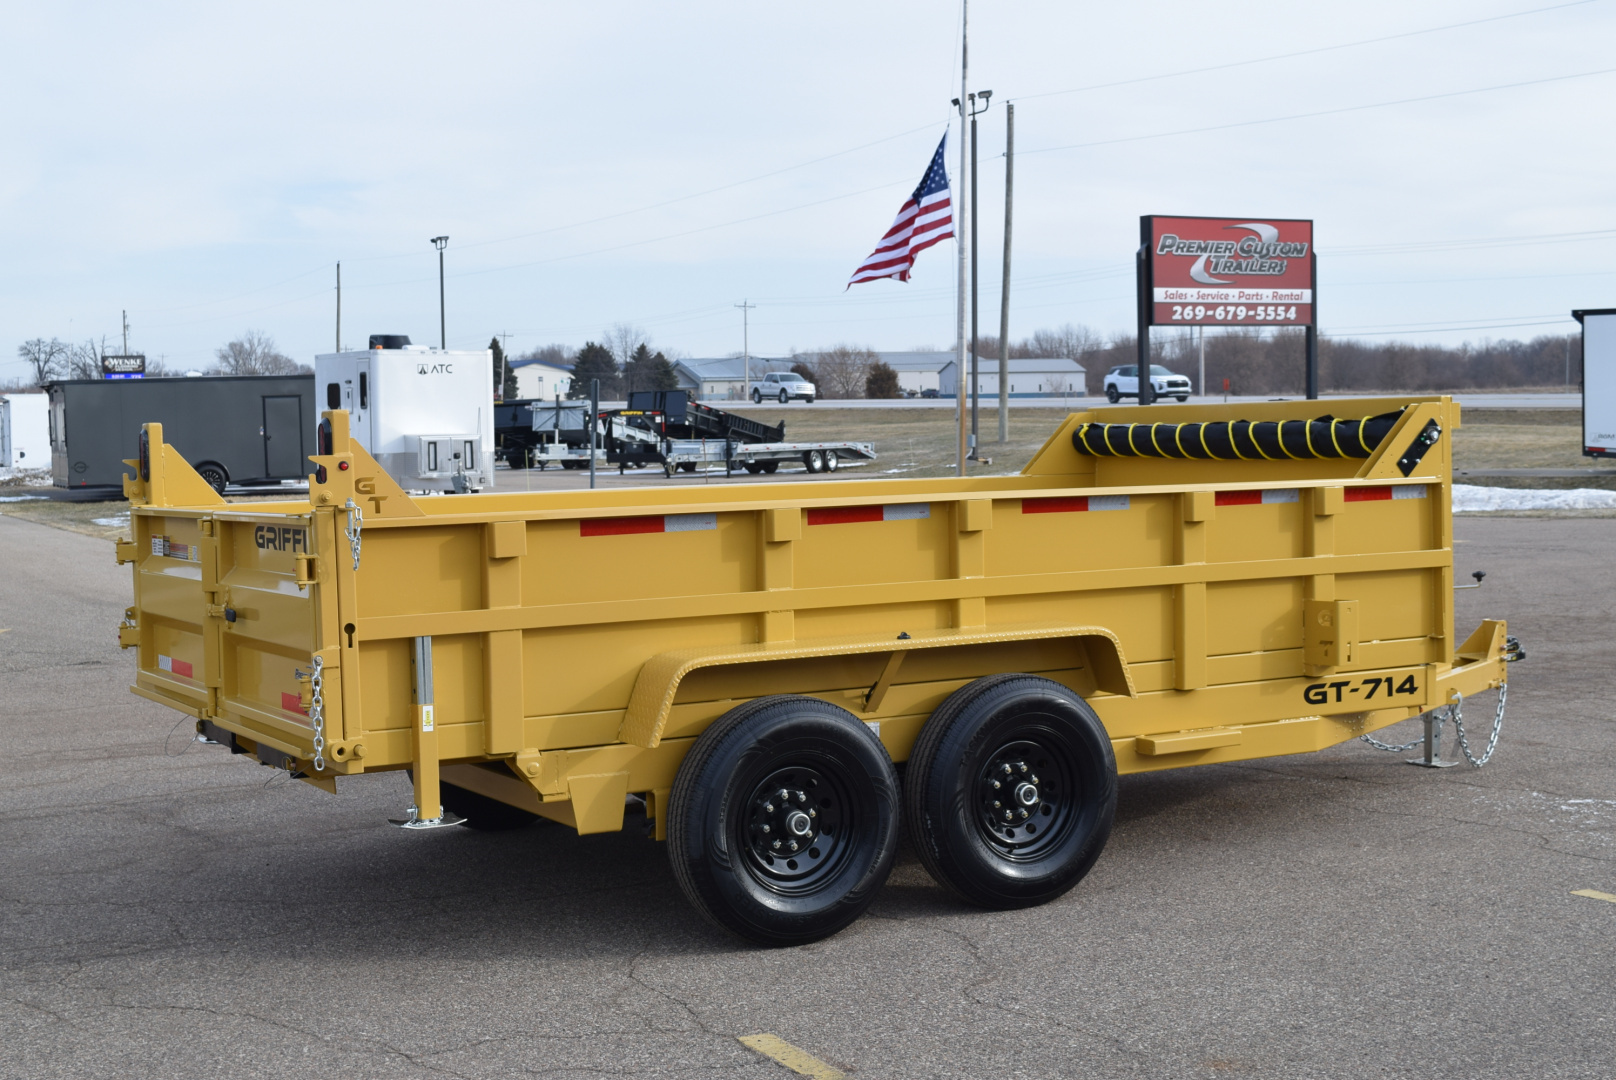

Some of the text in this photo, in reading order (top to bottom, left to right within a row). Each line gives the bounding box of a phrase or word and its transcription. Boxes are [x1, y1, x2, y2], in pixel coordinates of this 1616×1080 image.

[1157, 234, 1309, 259] PREMIER CUSTOM
[1210, 254, 1286, 275] TRAILERS
[1163, 290, 1304, 302] Sales Service Parts Rental
[1172, 305, 1297, 321] 269-679-5554
[431, 364, 453, 374] ATC
[1303, 674, 1419, 705] GT-714
